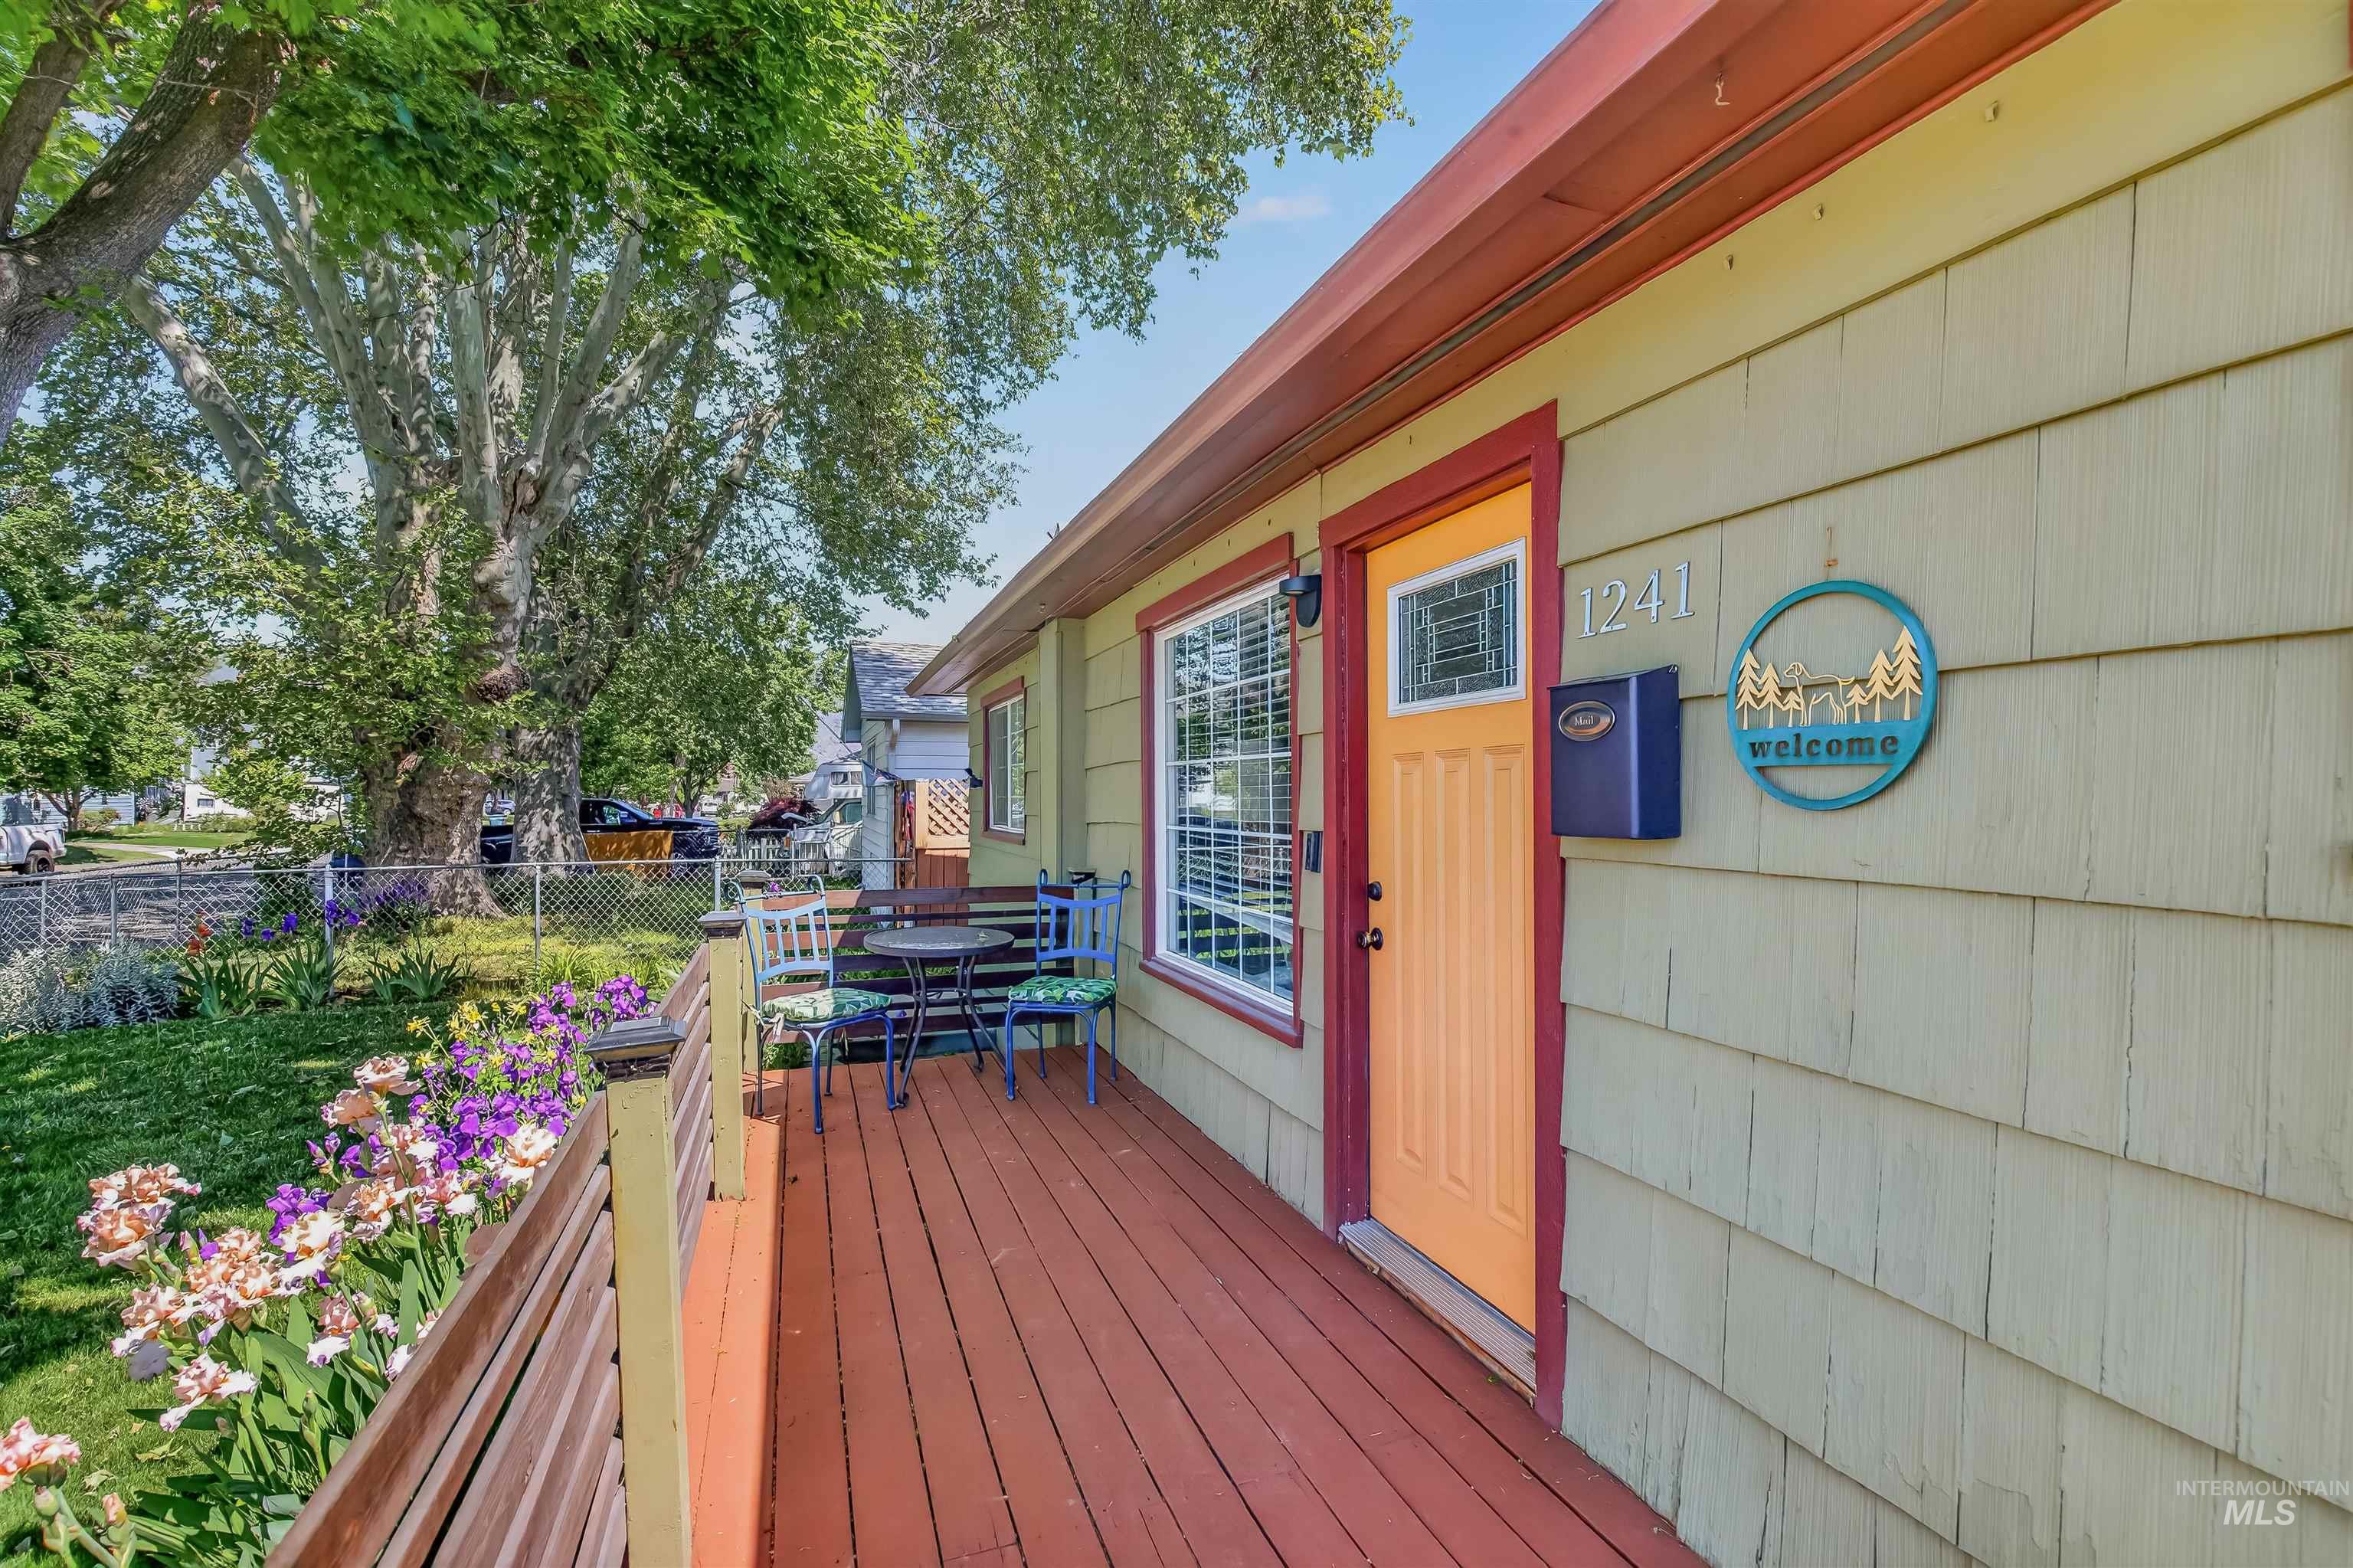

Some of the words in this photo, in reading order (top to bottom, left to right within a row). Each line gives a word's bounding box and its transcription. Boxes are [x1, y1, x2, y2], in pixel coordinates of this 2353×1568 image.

[1576, 561, 1695, 639] 1241
[1575, 715, 1594, 726] Mail
[1749, 733, 1899, 758] welcome
